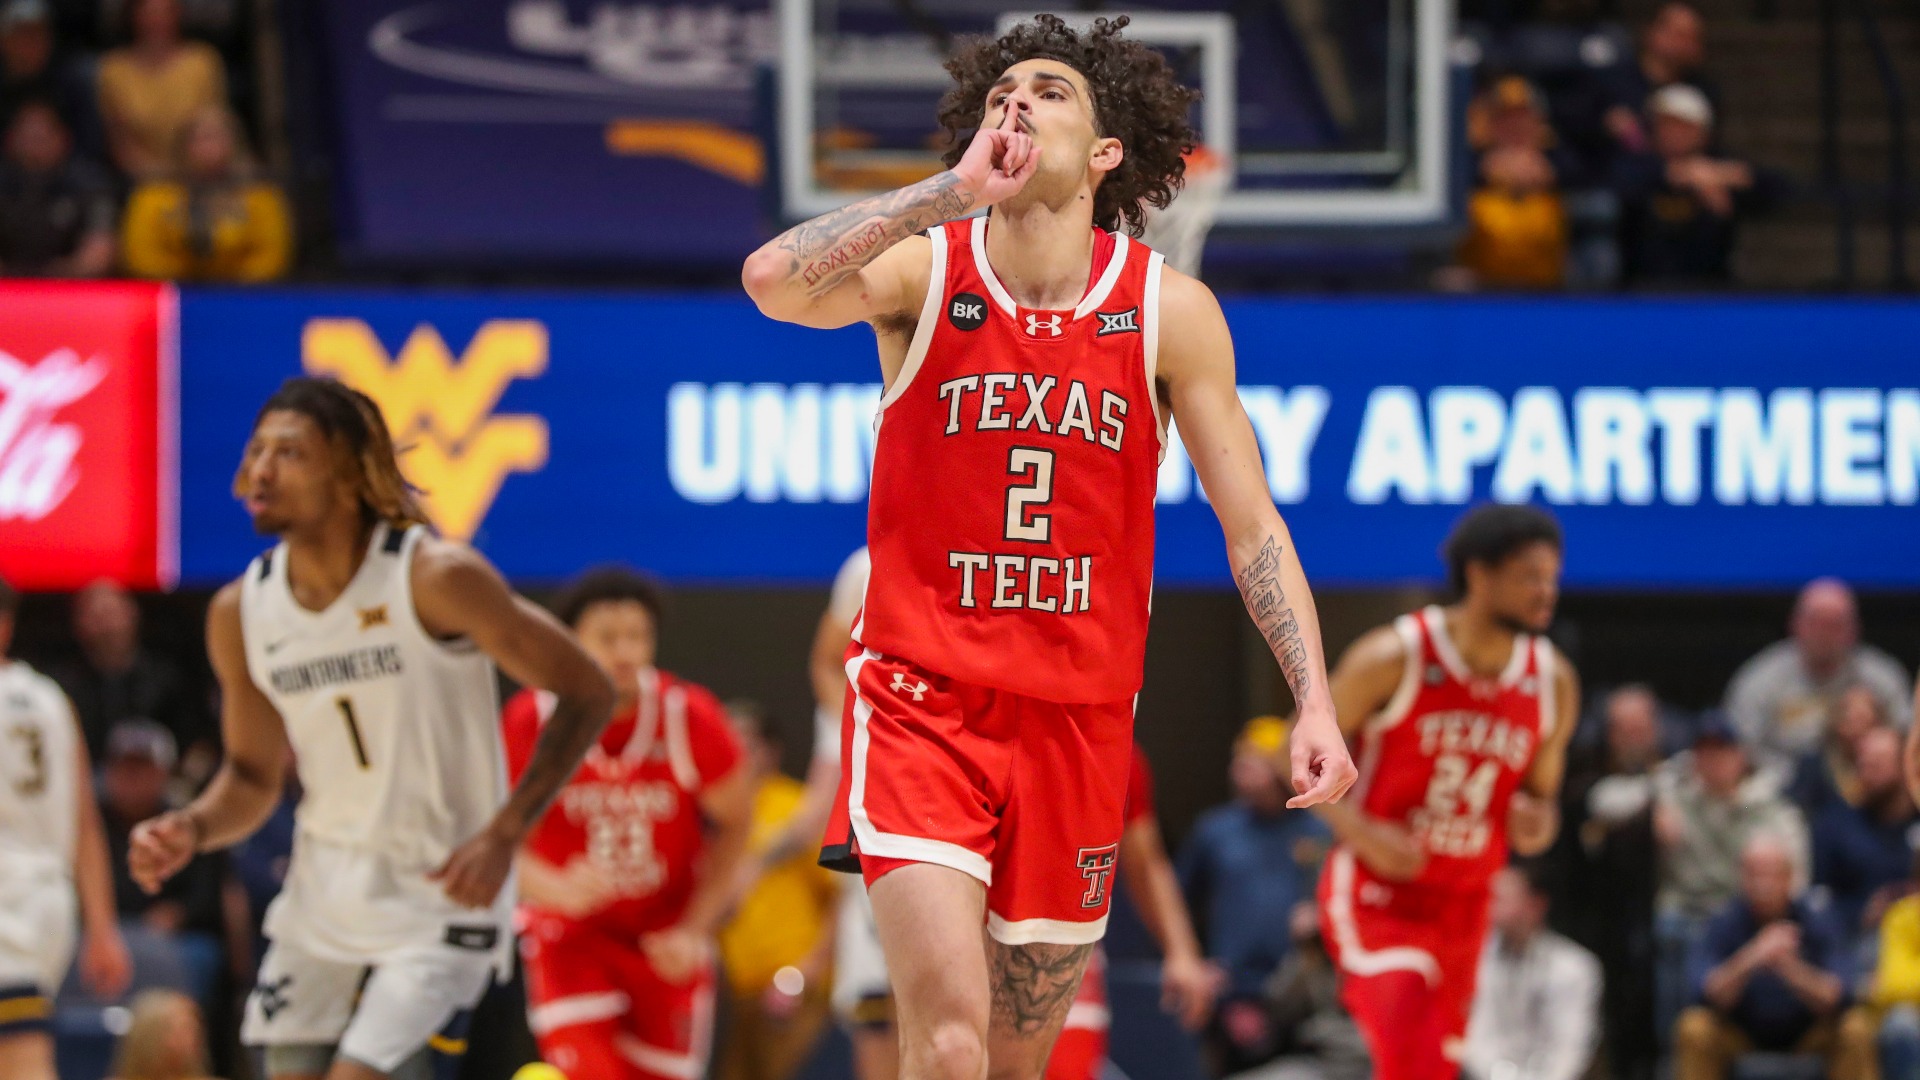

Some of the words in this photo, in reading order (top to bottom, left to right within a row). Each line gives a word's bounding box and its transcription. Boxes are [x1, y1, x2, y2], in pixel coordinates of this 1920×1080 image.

[952, 301, 983, 321] BK
[1097, 308, 1140, 334] XII
[938, 372, 1129, 453] TEXAS
[1003, 445, 1056, 544] 2
[949, 550, 1093, 614] TECH
[335, 695, 372, 771] 1
[1426, 754, 1500, 817] 24
